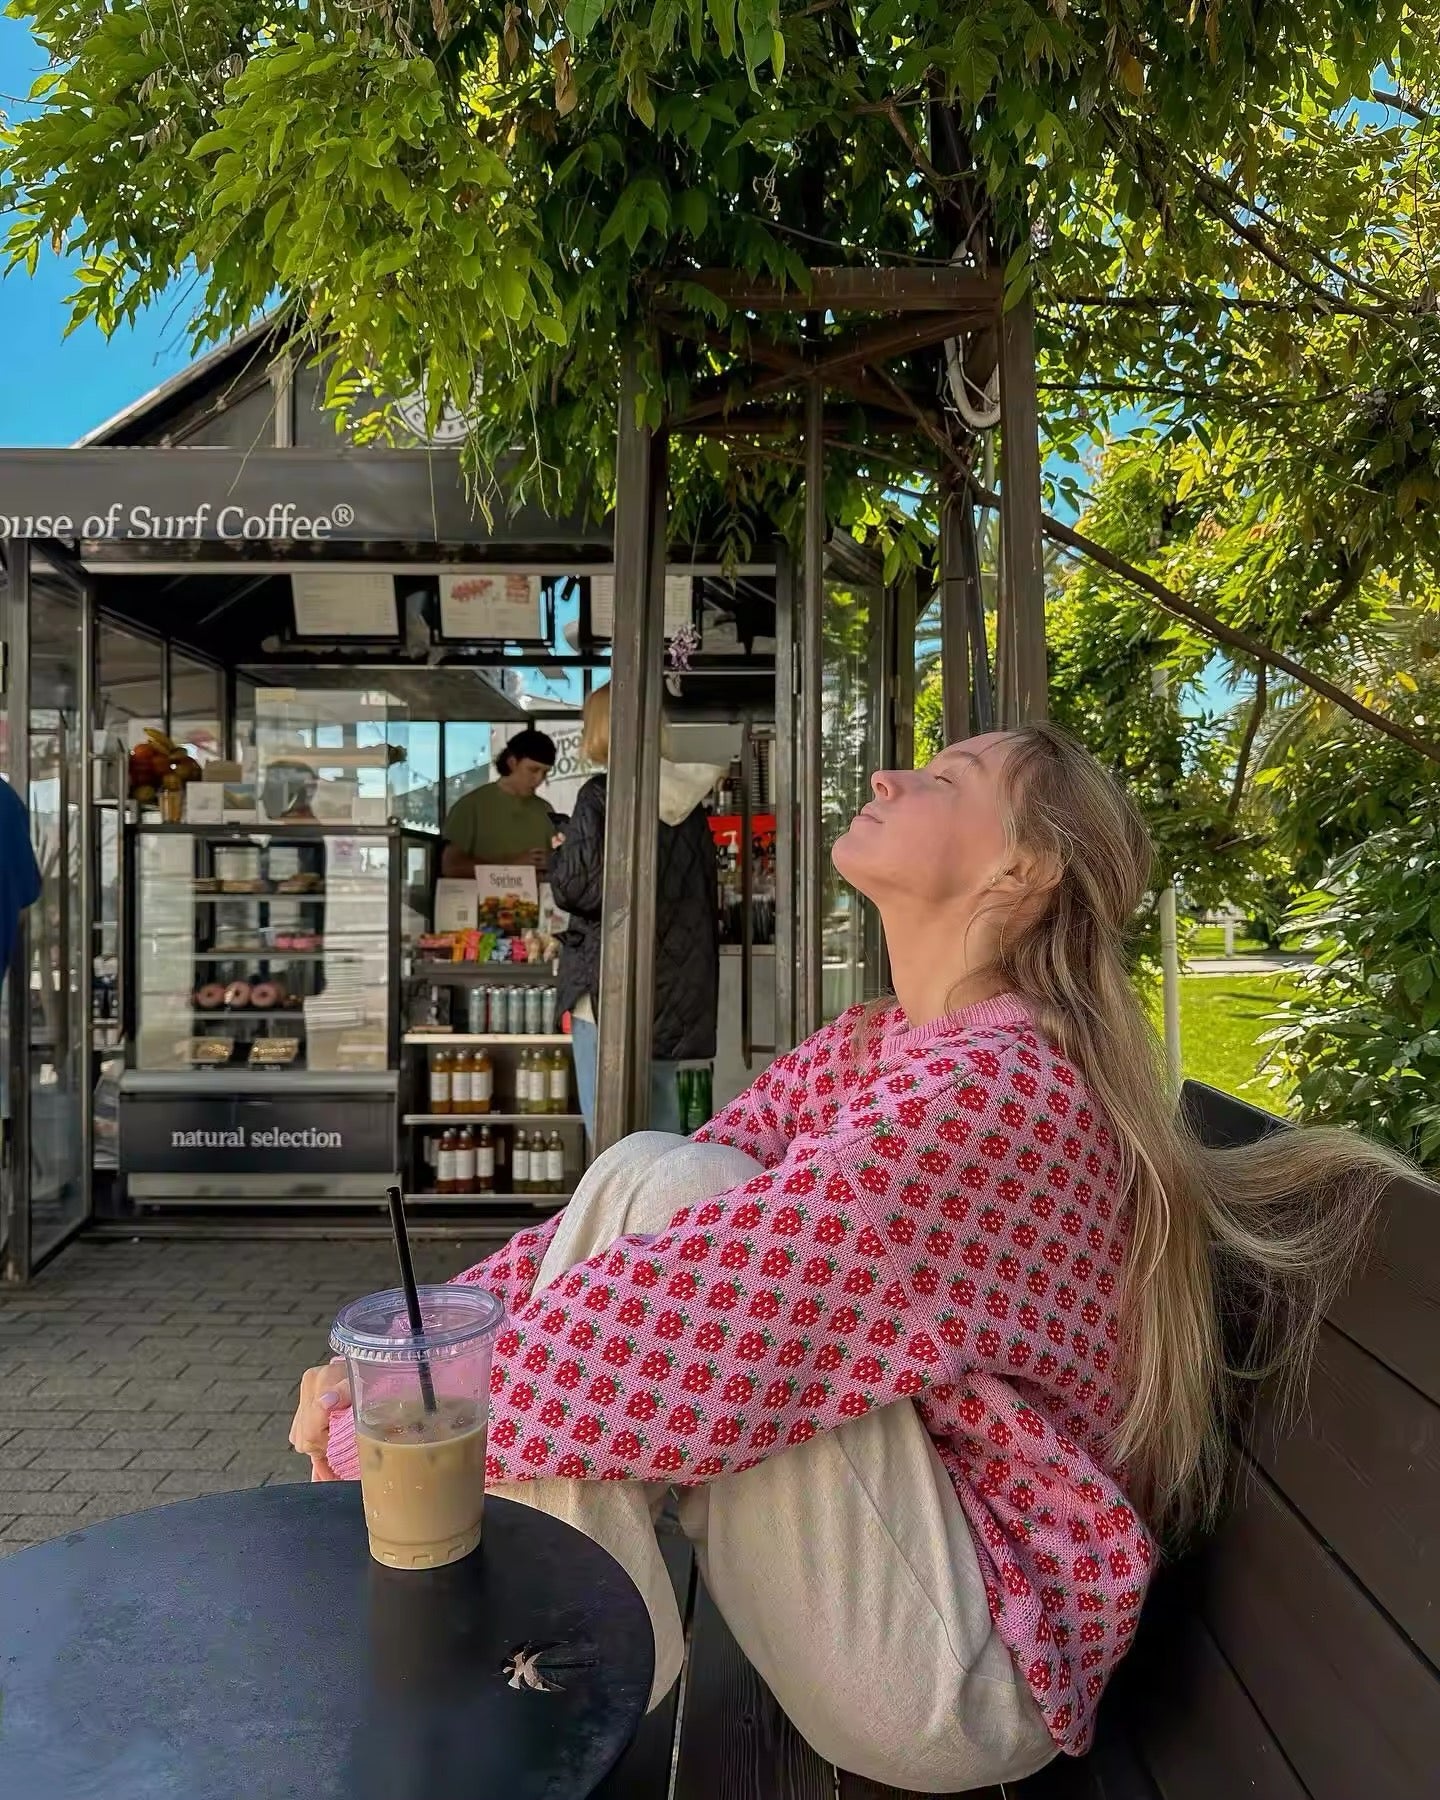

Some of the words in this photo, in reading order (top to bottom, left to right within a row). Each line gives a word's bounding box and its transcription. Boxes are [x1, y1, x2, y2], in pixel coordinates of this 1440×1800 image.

[82, 503, 123, 538] of
[127, 503, 211, 539] Surf
[489, 872, 523, 887] Spring
[171, 1126, 246, 1148] natural
[250, 1126, 342, 1148] selection
